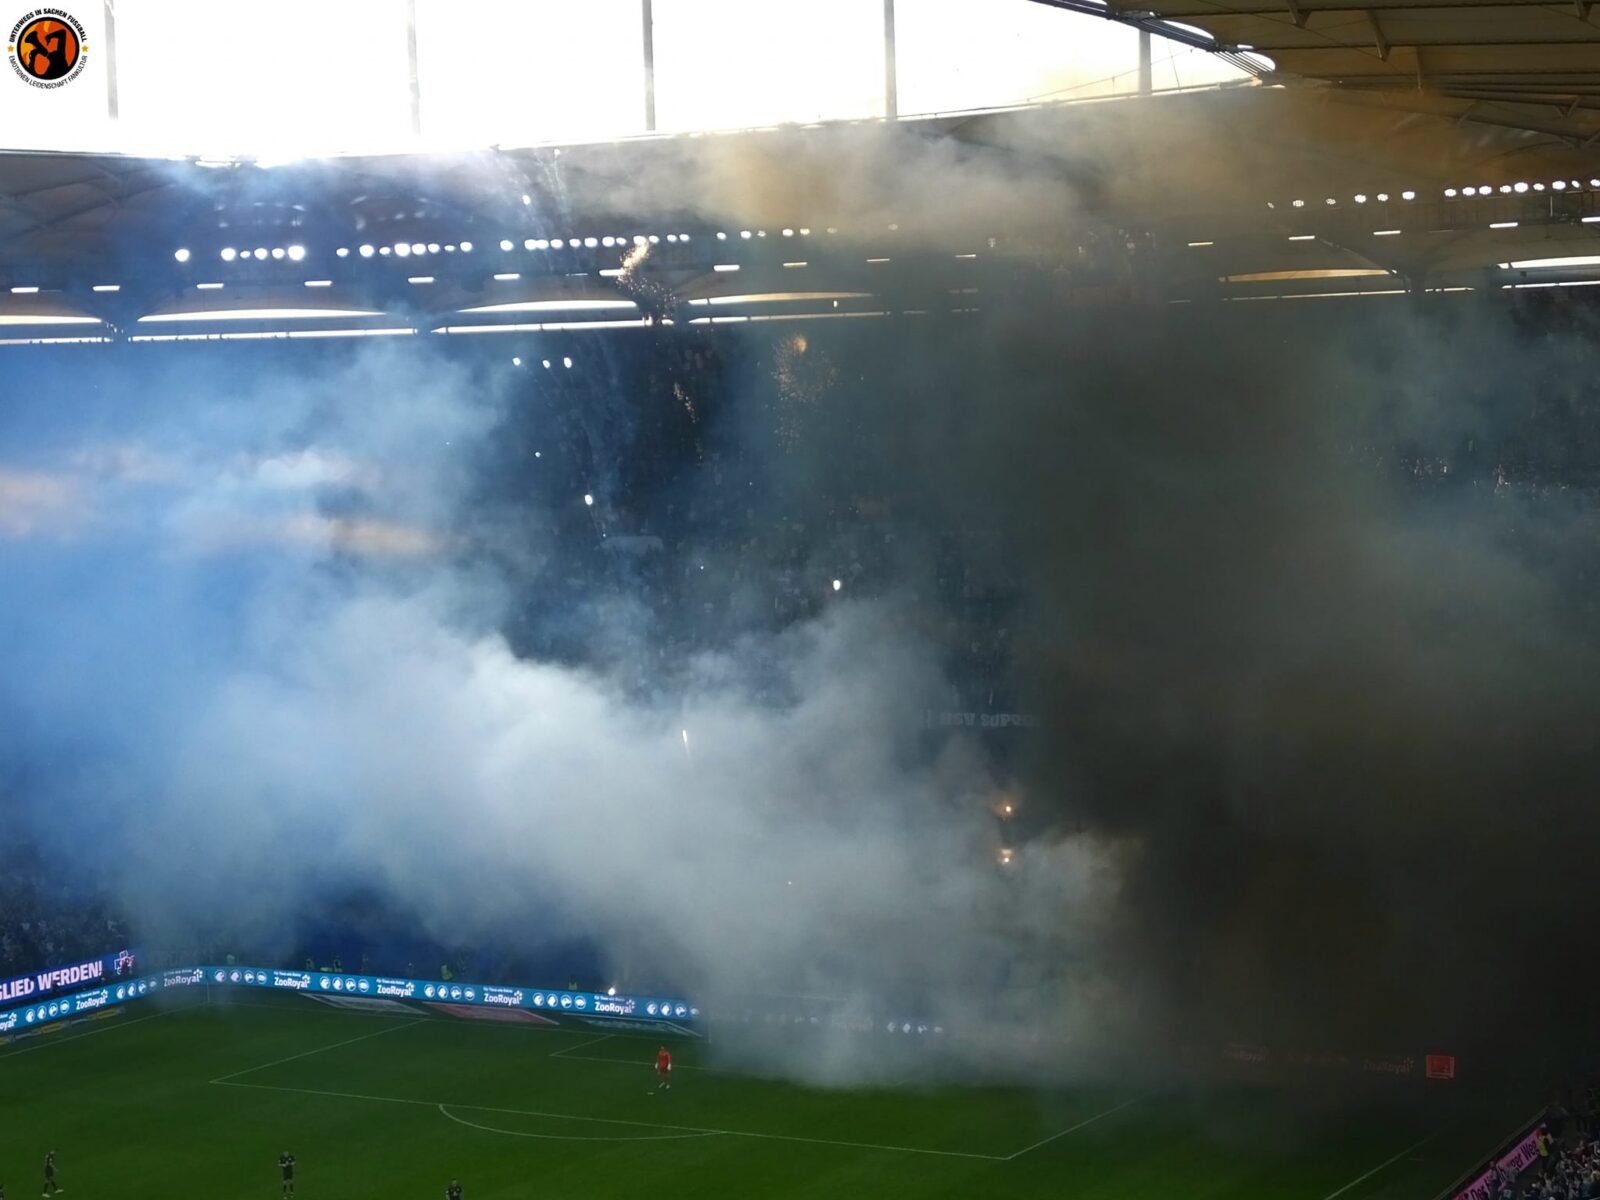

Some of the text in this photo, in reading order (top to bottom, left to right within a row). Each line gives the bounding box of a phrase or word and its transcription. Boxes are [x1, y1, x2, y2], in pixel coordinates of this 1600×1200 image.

[0, 960, 103, 1000] LIED WERDEN!
[163, 973, 200, 988] ZooRoyal
[274, 976, 309, 990] ZooRoyal
[376, 984, 412, 999] ZooRoyal
[75, 994, 107, 1011] ZooRoyal
[483, 993, 522, 1006] ZooRoyal
[594, 1001, 633, 1016] ZooRoyal
[0, 1020, 14, 1032] oyal
